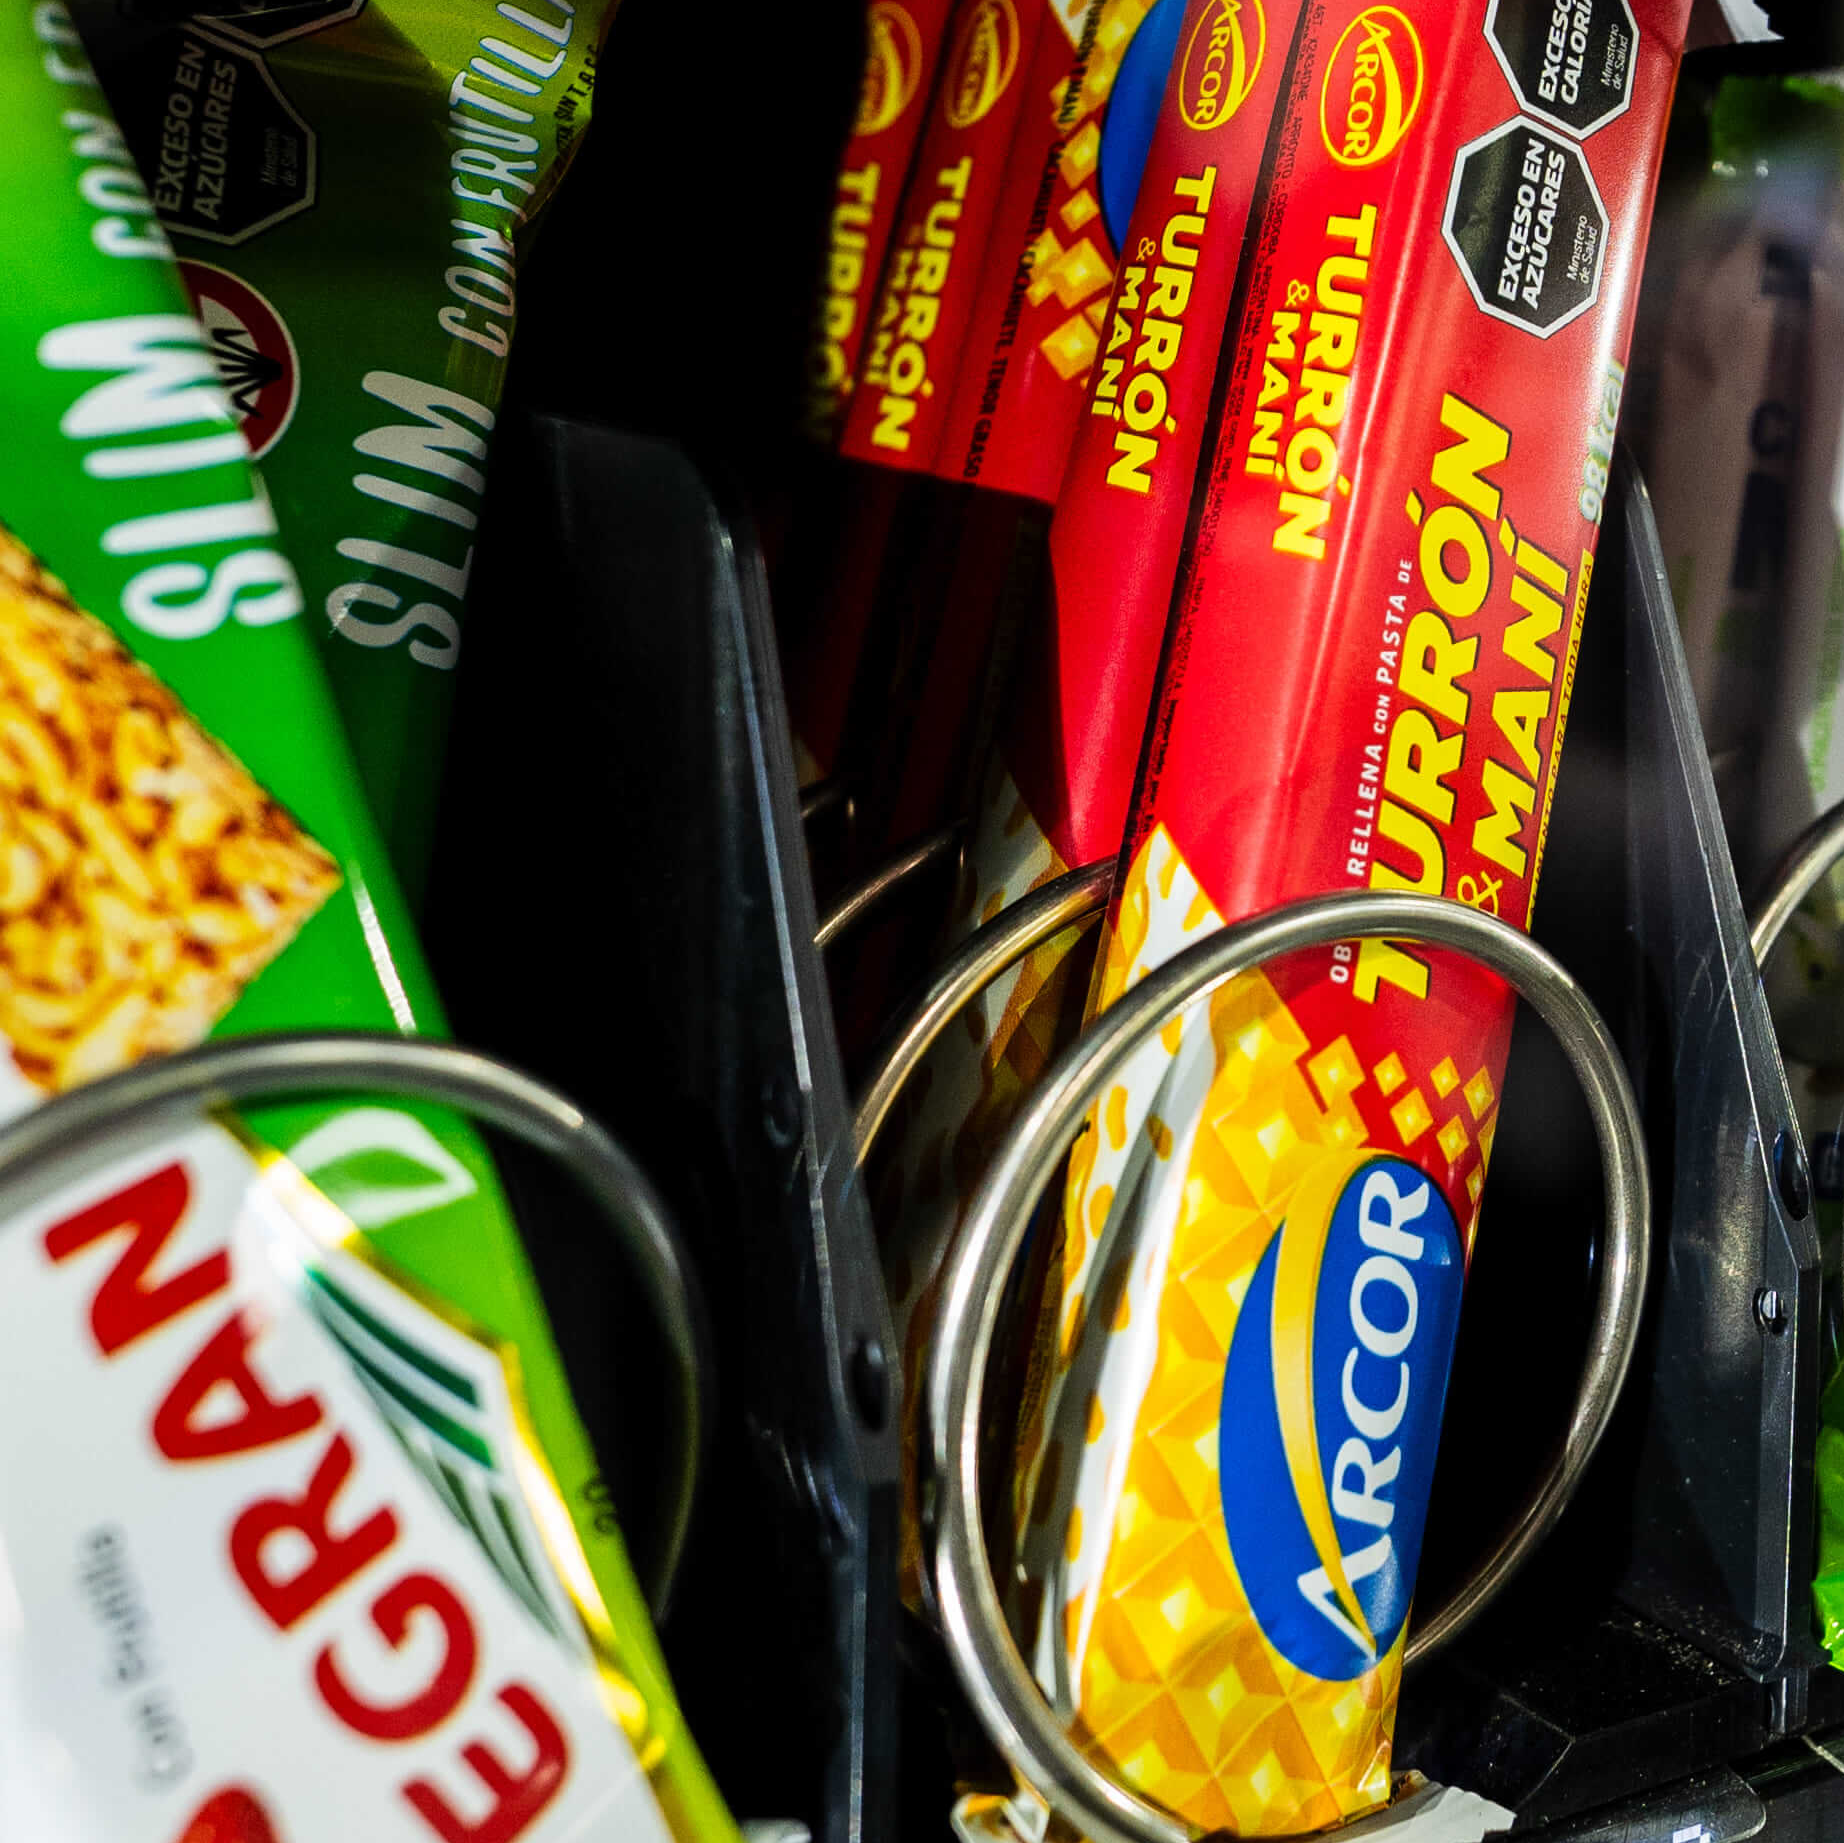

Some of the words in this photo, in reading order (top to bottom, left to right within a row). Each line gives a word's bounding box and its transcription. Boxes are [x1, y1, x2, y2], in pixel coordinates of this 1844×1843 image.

[1342, 13, 1402, 161] ARCOR
[438, 219, 517, 357] CON
[1288, 278, 1310, 306] &
[1498, 177, 1537, 302] EXCESO
[1524, 137, 1548, 178] EN
[1521, 151, 1567, 311] AZÚCARES
[870, 155, 973, 452] TURRÓN
[1091, 264, 1148, 422] MANÍ
[1105, 164, 1217, 495] TURRÓN
[1273, 204, 1379, 560] TURRÓN
[1244, 310, 1302, 479] MANÍ
[37, 312, 305, 641] SLIM
[325, 369, 497, 670] SLIM
[1377, 591, 1409, 687] PASTA
[1396, 556, 1414, 586] DE
[1562, 637, 1581, 703] TODA
[1575, 561, 1594, 632] HORA
[1352, 392, 1514, 1006] TURRÓN
[1373, 695, 1393, 737] CON
[1471, 517, 1571, 881] MANÍ
[1346, 741, 1384, 877] RELLENA
[1296, 1167, 1431, 1660] ARCOR
